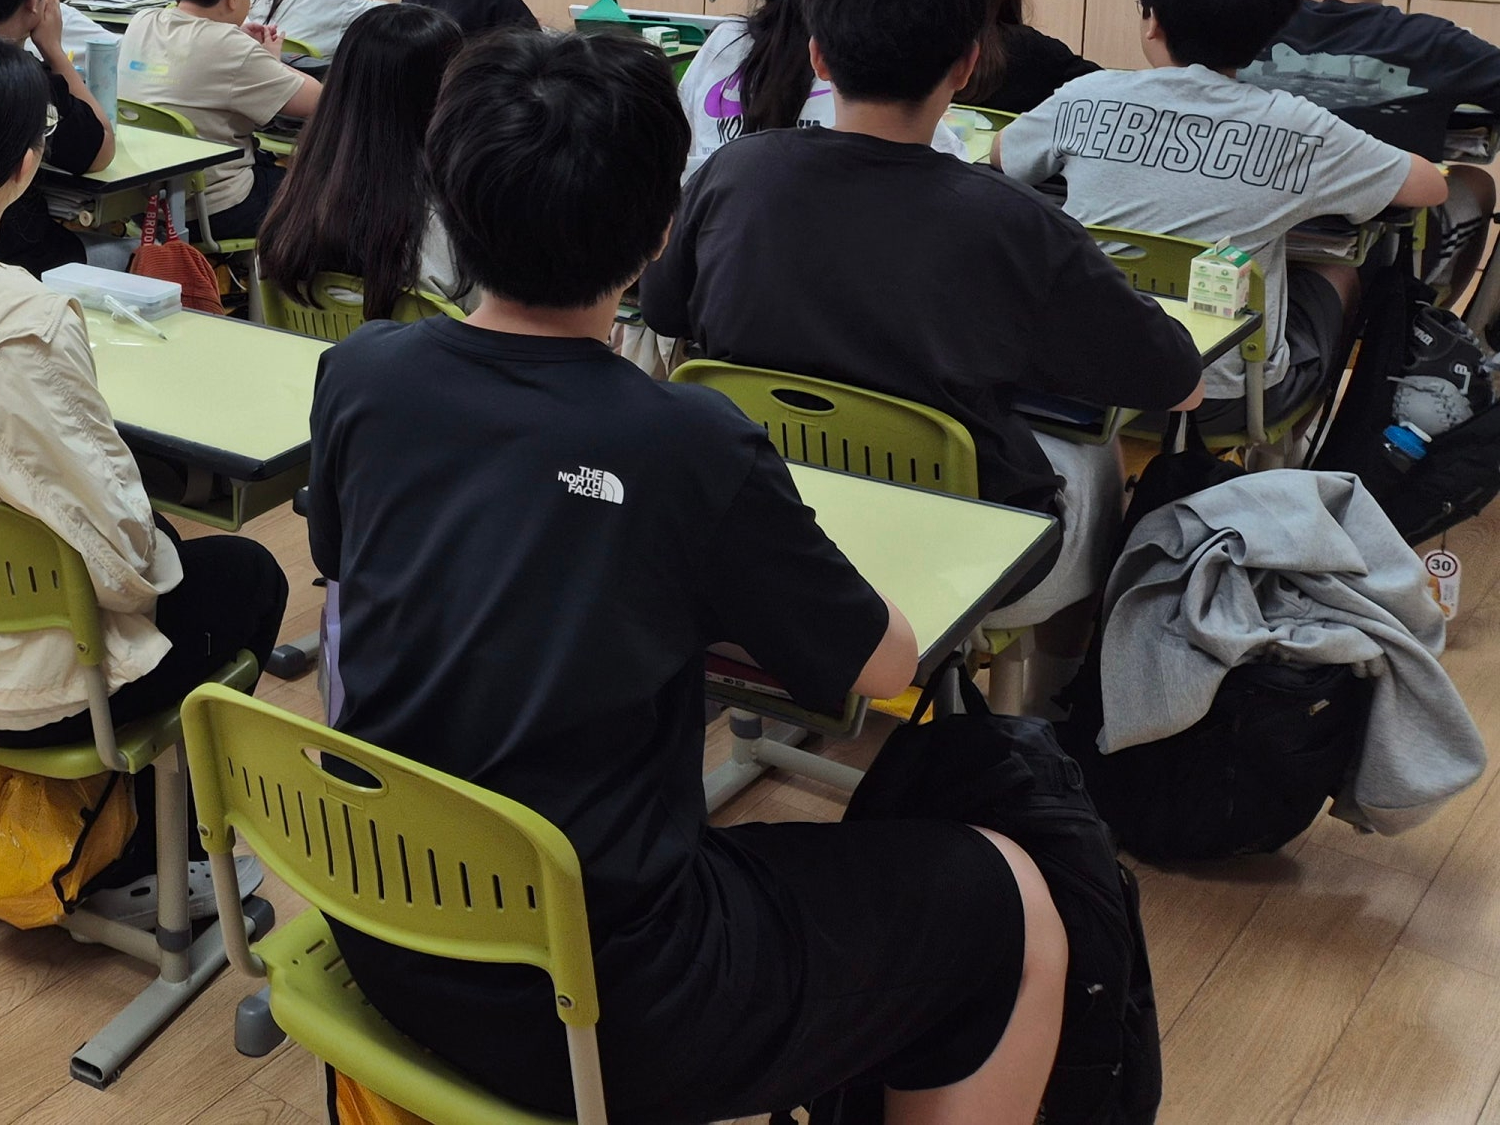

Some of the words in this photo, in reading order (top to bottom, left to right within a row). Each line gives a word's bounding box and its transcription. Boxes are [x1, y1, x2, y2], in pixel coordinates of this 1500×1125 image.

[1052, 99, 1324, 195] ICEBISCUIT
[558, 471, 602, 490] NORTH
[579, 465, 603, 480] THE
[568, 483, 600, 499] FACE
[1431, 559, 1451, 572] 30
